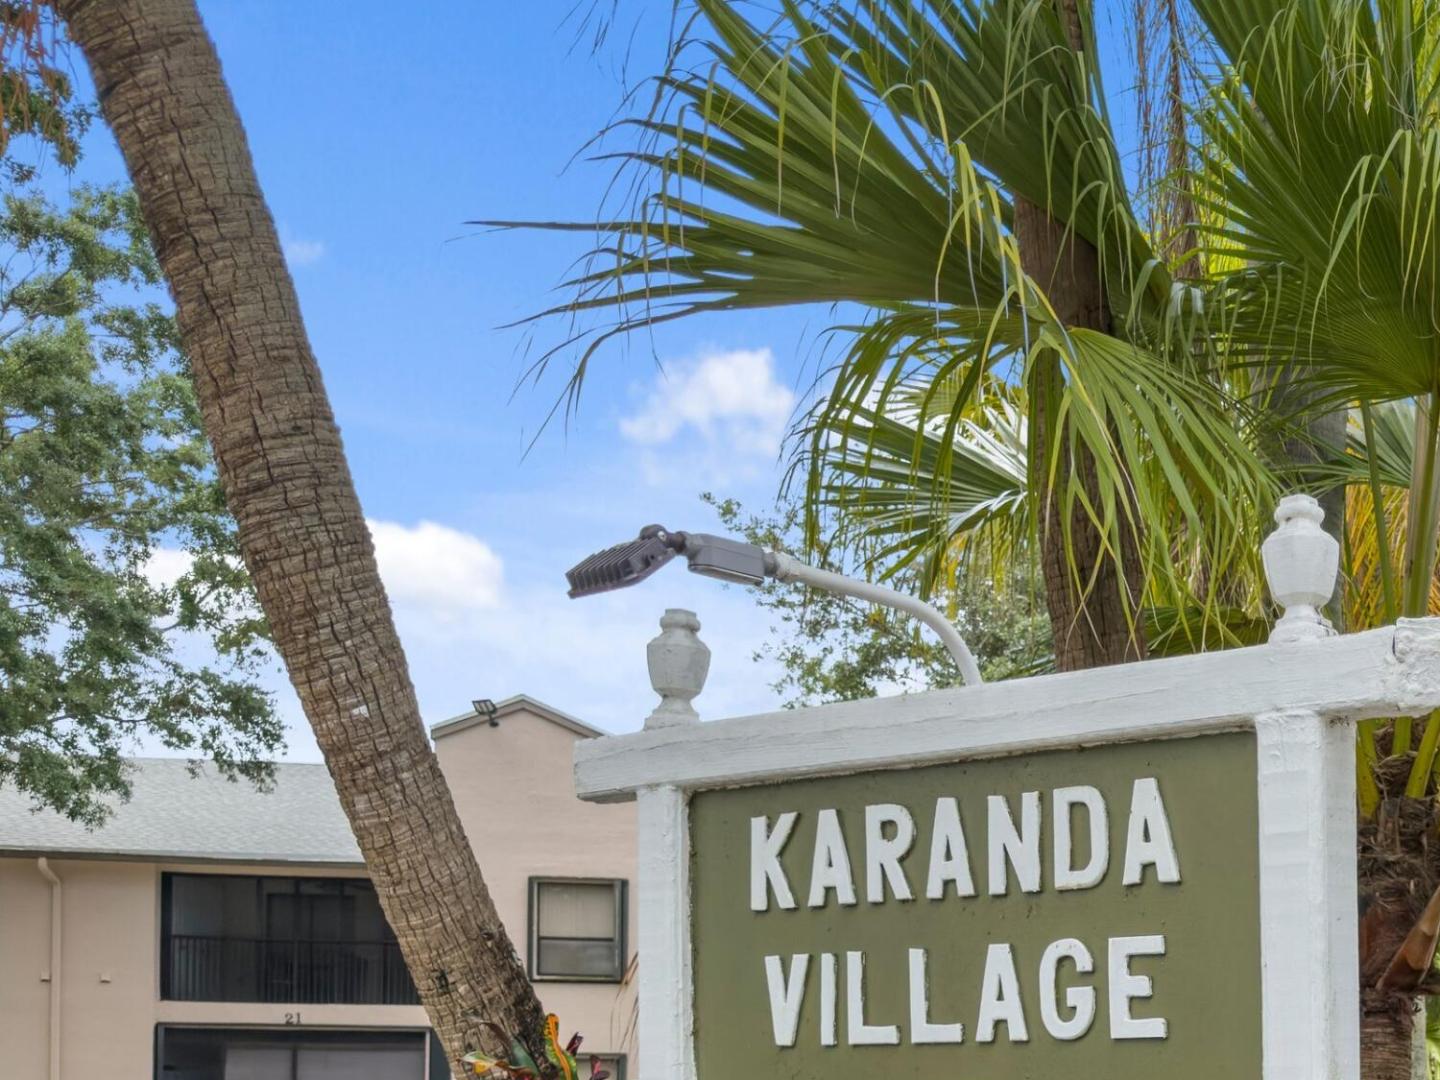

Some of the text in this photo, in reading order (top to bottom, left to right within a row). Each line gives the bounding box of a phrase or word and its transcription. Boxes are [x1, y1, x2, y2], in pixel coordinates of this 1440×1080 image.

[750, 777, 1180, 911] KARANDA
[284, 1012, 301, 1025] 21
[764, 935, 1167, 1046] VILLAGE
